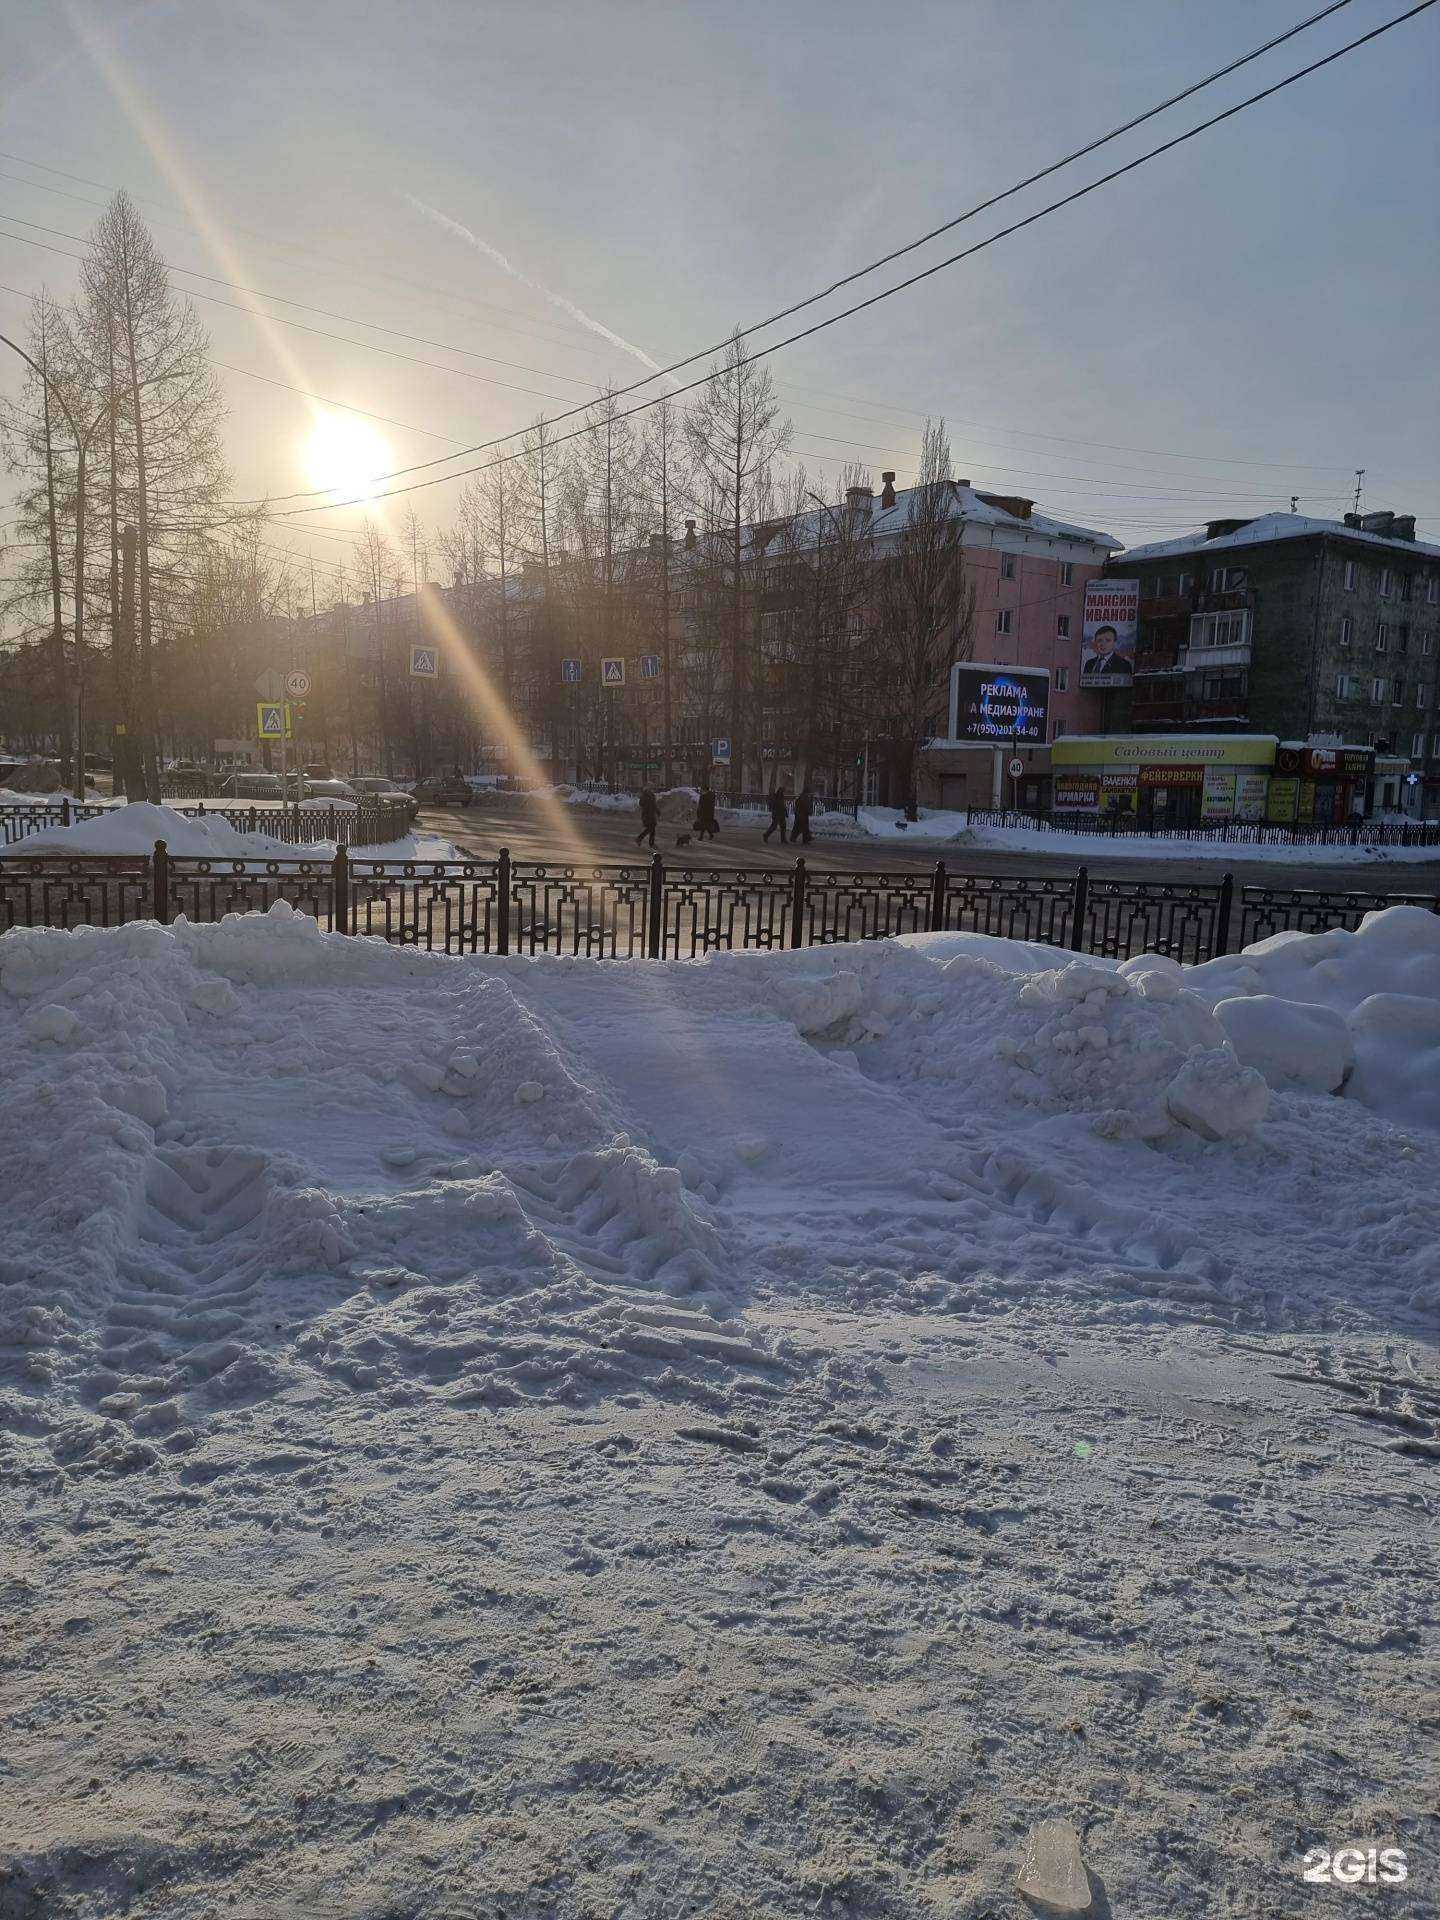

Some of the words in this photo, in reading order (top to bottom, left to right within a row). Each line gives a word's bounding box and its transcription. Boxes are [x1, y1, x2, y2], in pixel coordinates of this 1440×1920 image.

[1087, 594, 1137, 607] МАКСИМ
[1085, 608, 1137, 622] ИВАНОВ
[290, 678, 306, 689] 40
[980, 683, 1028, 699] РЕКЛАМА
[979, 703, 1044, 718] МЕДИАЭКРАНЕ
[966, 722, 1039, 737] +7(950)20134-40
[1114, 746, 1178, 758] Садовый
[1181, 748, 1225, 760] центр
[1141, 768, 1203, 781] ФЕЙЕРВЕРКИ
[1102, 776, 1137, 787] ВАЛЕНКИ
[1057, 791, 1096, 803] ЯРМАРКА
